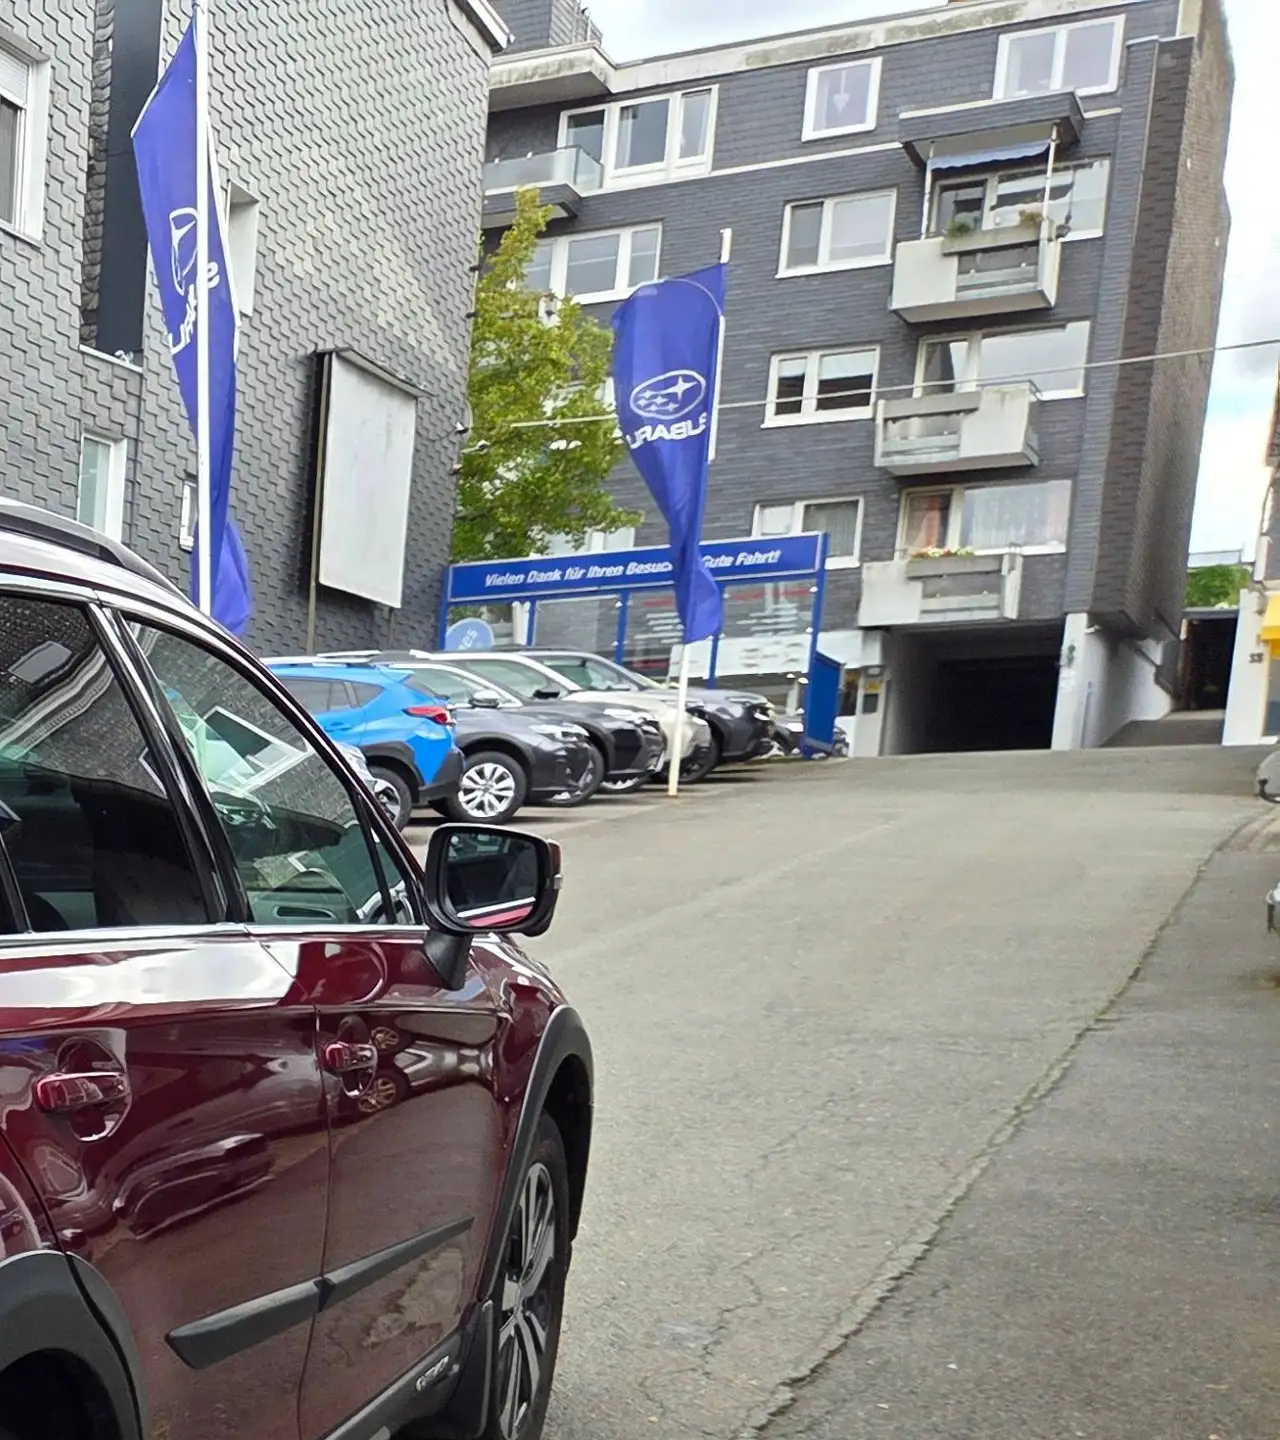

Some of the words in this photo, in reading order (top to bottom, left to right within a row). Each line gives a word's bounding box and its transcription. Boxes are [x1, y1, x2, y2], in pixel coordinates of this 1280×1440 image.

[485, 571, 525, 587] Vielen
[526, 568, 562, 584] Dank
[564, 566, 586, 580] für
[586, 562, 624, 579] Ihren
